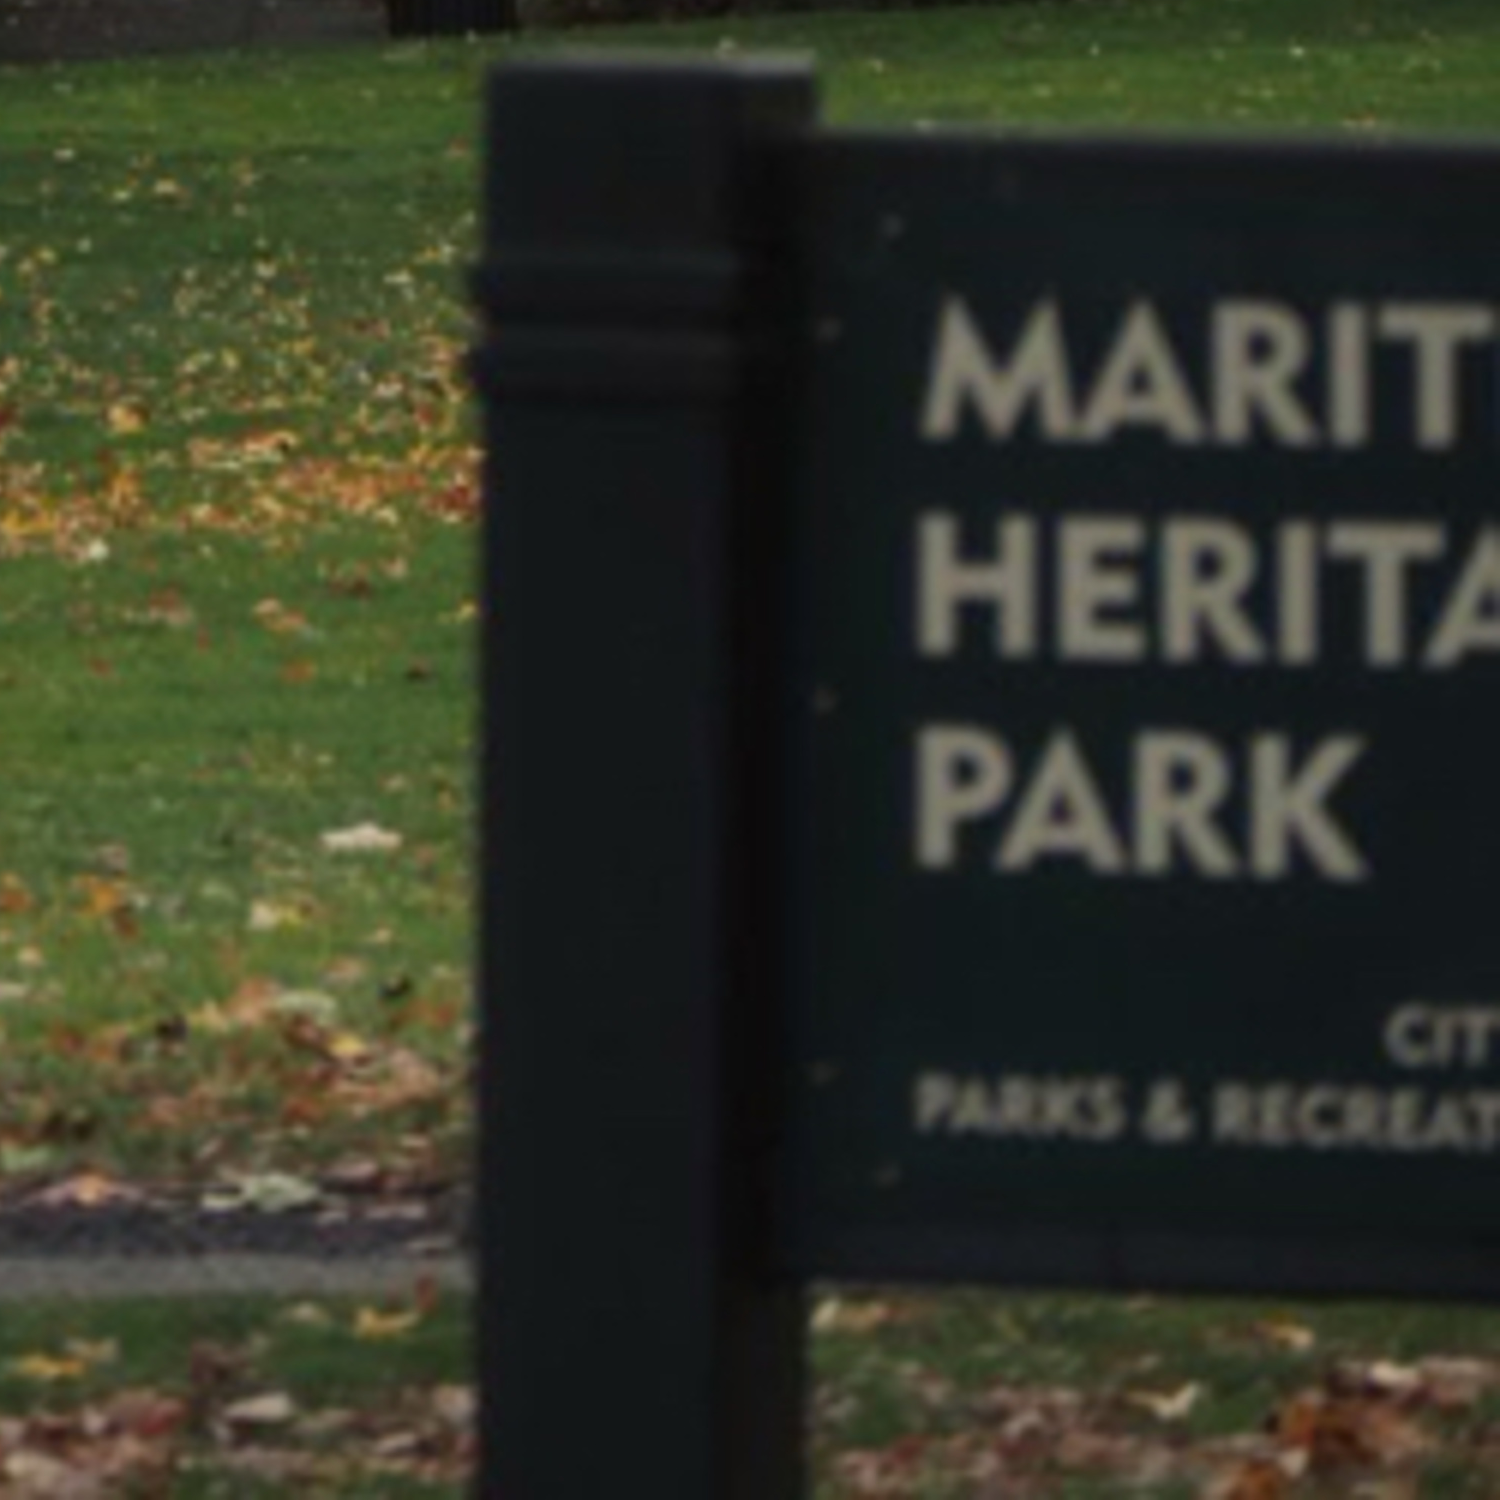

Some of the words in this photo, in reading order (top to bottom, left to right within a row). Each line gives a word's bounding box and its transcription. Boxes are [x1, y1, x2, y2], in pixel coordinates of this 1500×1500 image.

[922, 296, 1496, 448] MARIT
[919, 512, 1500, 667] HERITA
[918, 724, 1368, 882] PARK
[916, 1072, 1126, 1141] PARKS
[1143, 1077, 1192, 1143] &
[1214, 1080, 1500, 1151] RECREAT
[1384, 1003, 1500, 1068] CIT
